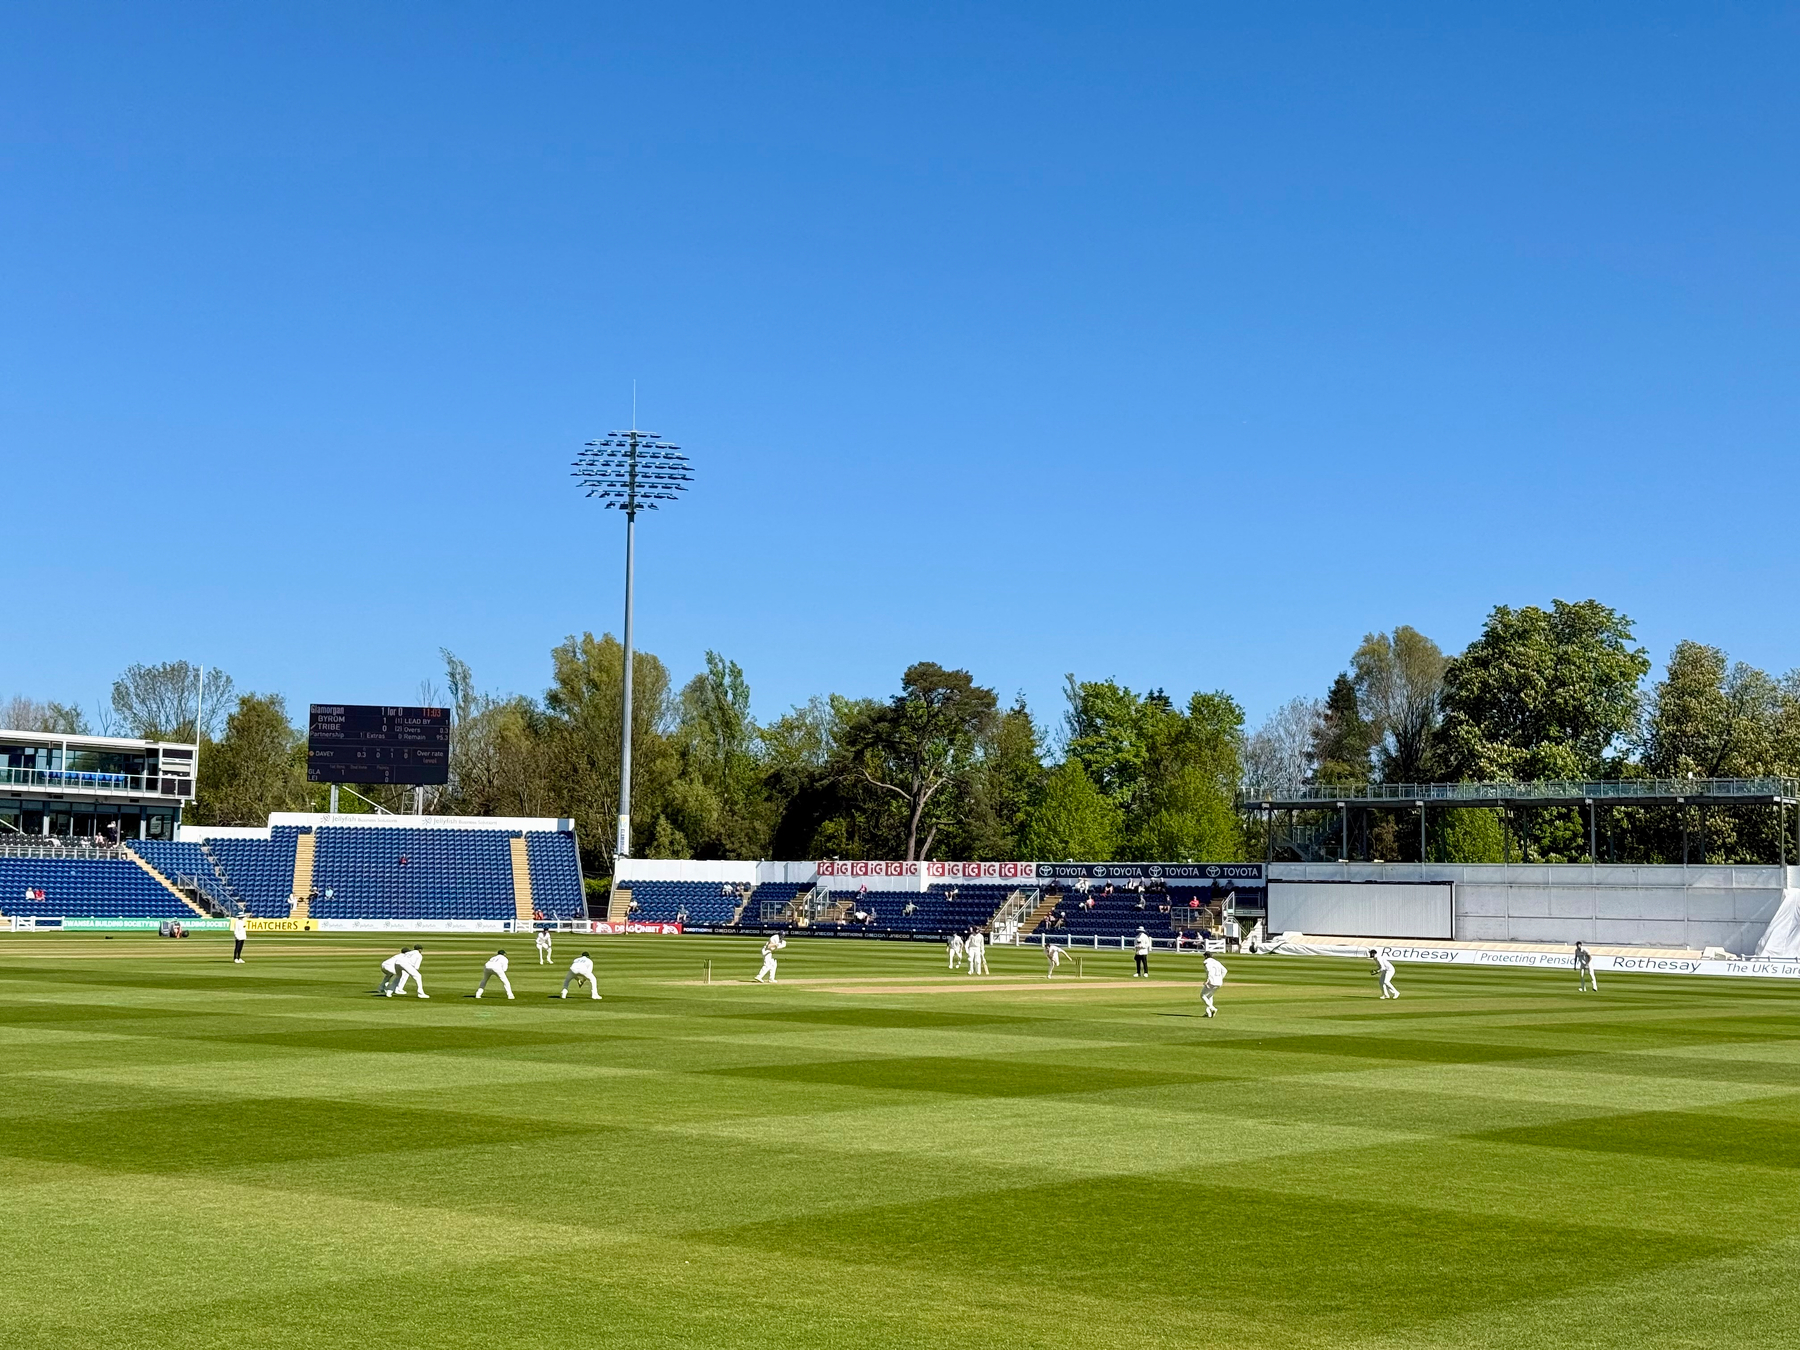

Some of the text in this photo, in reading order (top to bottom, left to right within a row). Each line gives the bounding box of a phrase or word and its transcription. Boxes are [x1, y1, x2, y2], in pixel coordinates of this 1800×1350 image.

[310, 704, 345, 715] Glamorgan
[423, 708, 441, 718] 11:03
[310, 730, 344, 739] Partnership
[1055, 867, 1258, 876] TOYOTA TOYOTA TOYOTA TOYOTA
[246, 920, 298, 930] THATCHERS
[1381, 947, 1459, 962] Rothesay
[1480, 953, 1536, 965] Protecting
[1613, 956, 1702, 973] Rothesay
[1726, 963, 1748, 972] The
[1752, 964, 1778, 974] UK's
